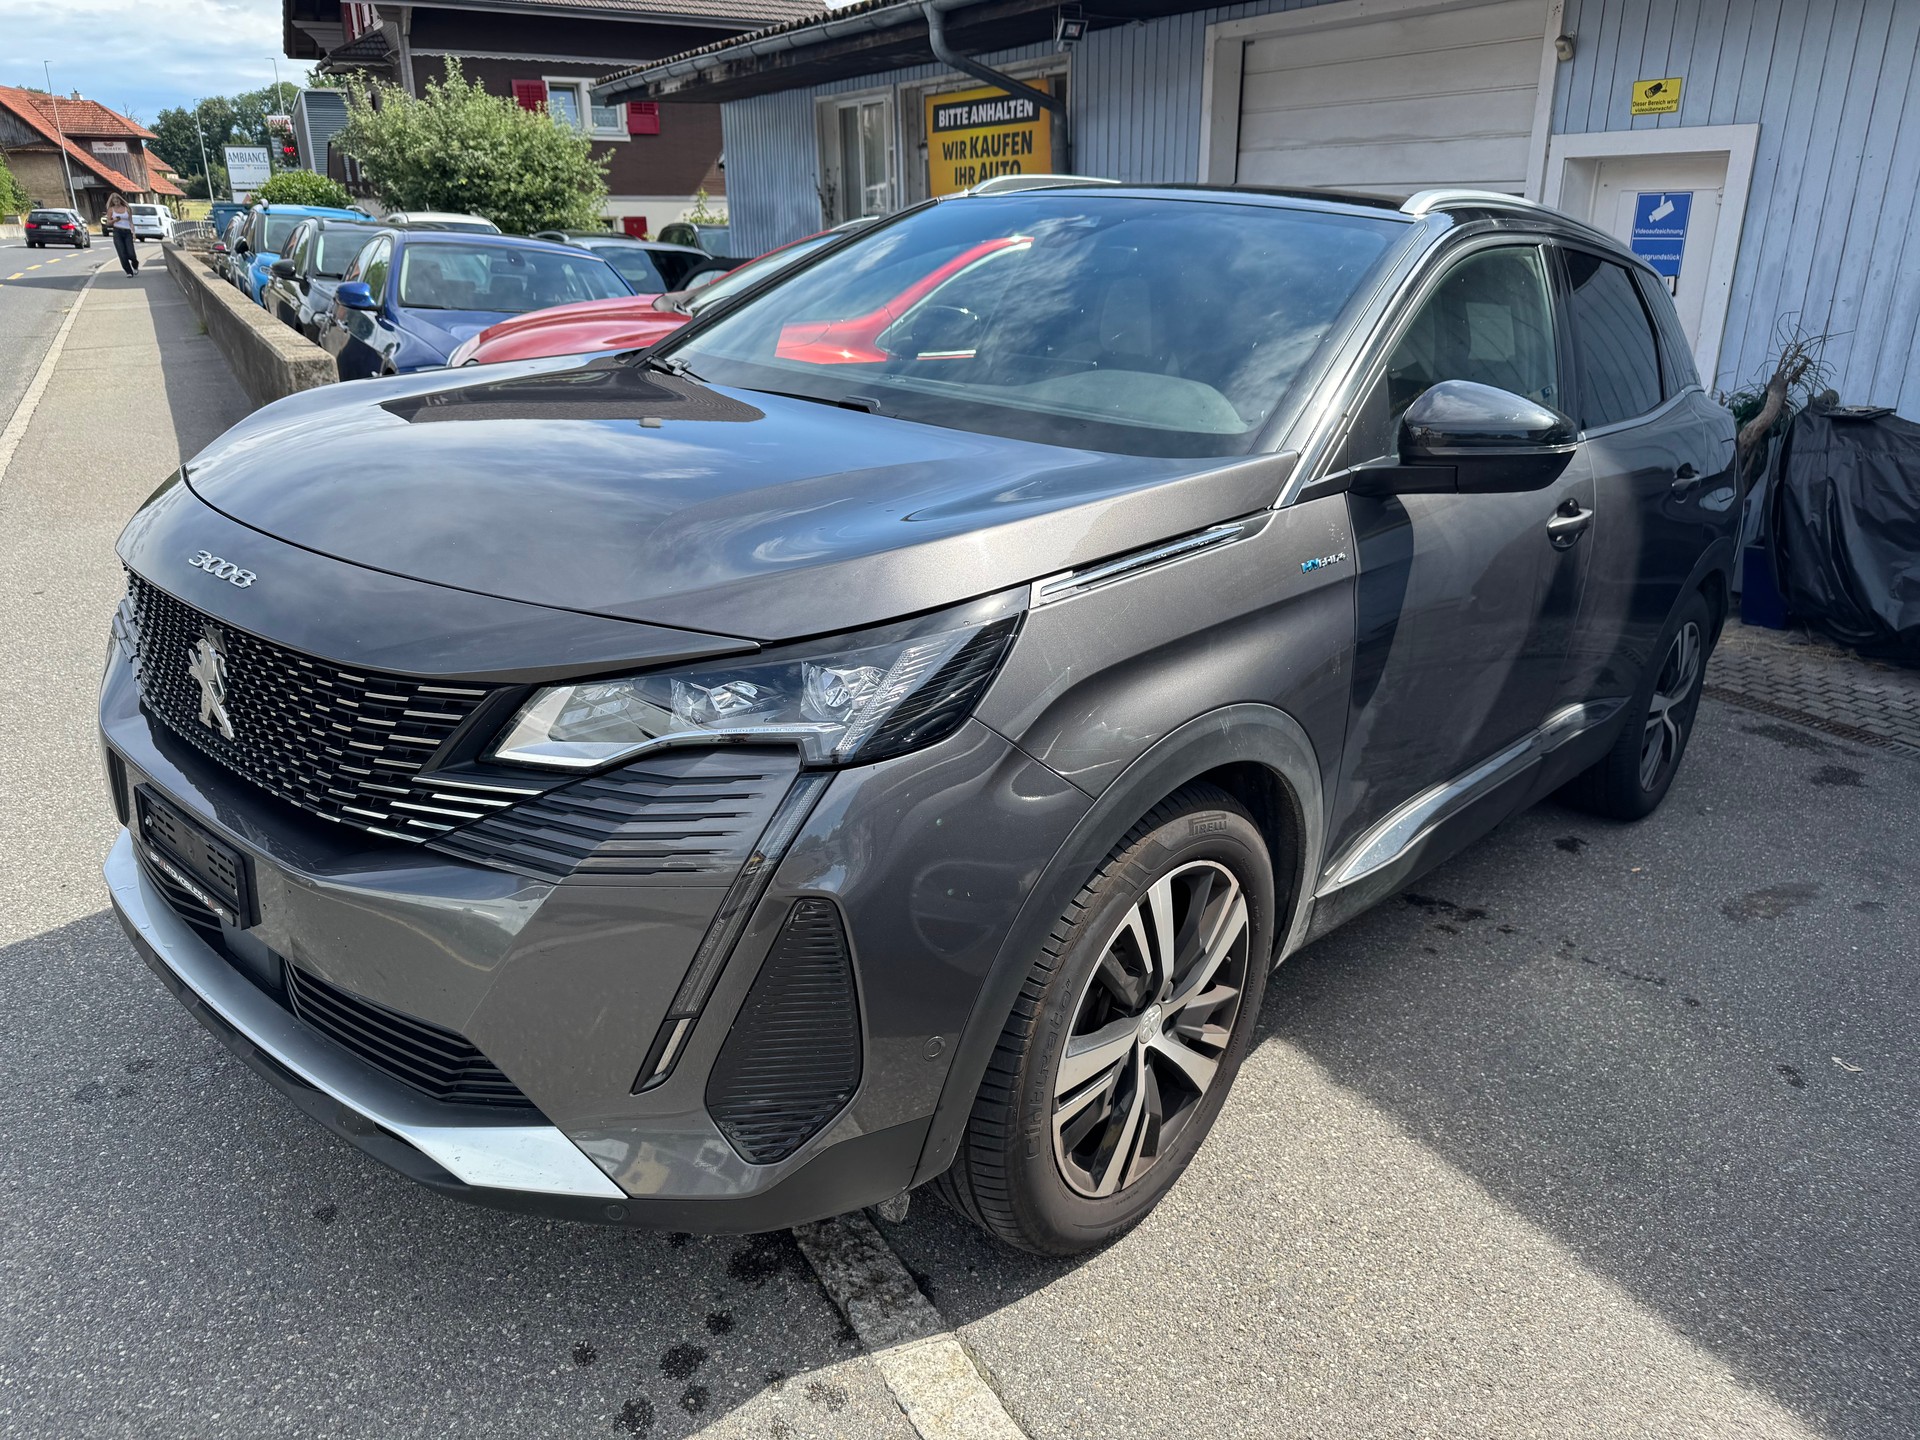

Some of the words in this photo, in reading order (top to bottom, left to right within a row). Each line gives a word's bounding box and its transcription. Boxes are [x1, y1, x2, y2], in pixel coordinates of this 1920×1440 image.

[938, 106, 969, 128] BITTE
[970, 98, 1034, 124] ANHALTEN
[228, 151, 268, 164] AMBIANCE
[942, 139, 967, 161] WIR
[969, 129, 1033, 160] KAUFEN
[954, 165, 976, 187] IHR
[978, 159, 1022, 185] AUTO
[1635, 227, 1684, 236] Videoaufzeichnung
[187, 549, 258, 589] 3008
[1187, 812, 1228, 837] PIRELLI
